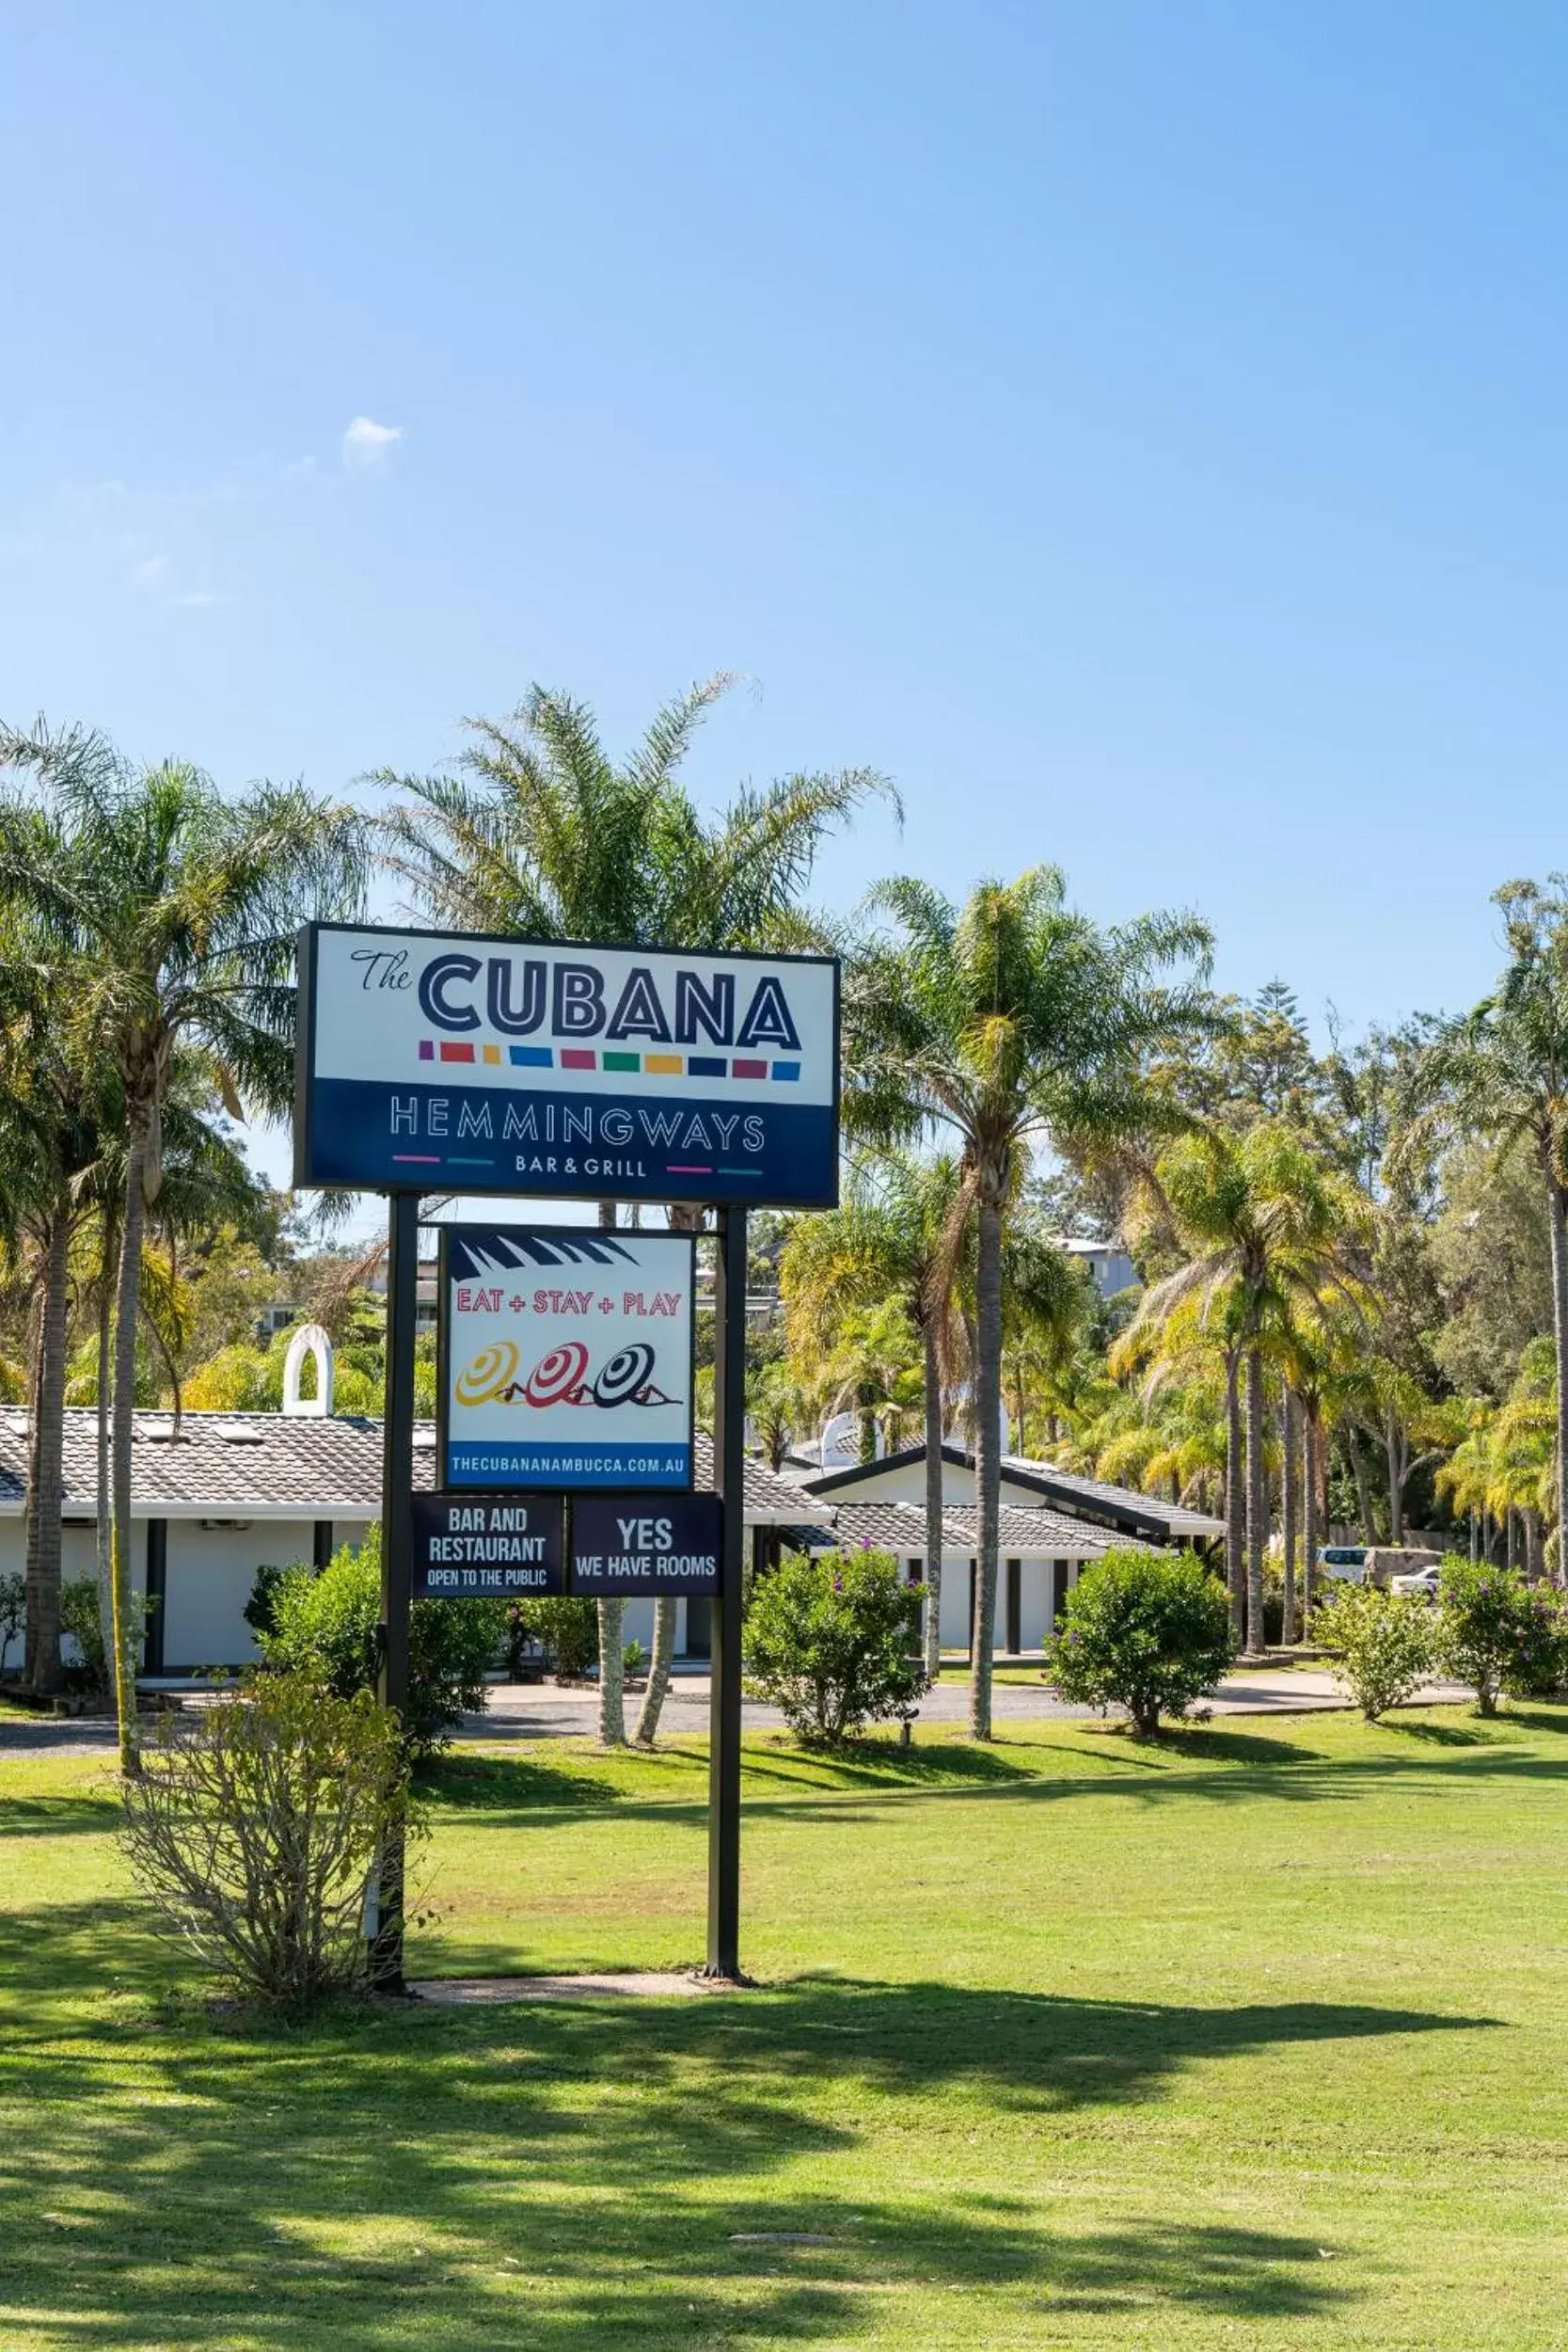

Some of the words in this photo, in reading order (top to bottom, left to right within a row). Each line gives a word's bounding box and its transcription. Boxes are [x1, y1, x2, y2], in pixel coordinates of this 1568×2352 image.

[350, 949, 412, 990] The
[418, 953, 802, 1051] CUBANA
[390, 1095, 766, 1152] HEMMINGWAYS
[457, 1288, 503, 1312] EAT
[532, 1289, 594, 1314] STAY
[623, 1292, 682, 1316] PLAY
[451, 1456, 684, 1472] THECUBANANAMBUCCA.COM.AU
[449, 1508, 487, 1532] BAR
[489, 1508, 527, 1532] AND
[617, 1518, 673, 1550] YES
[429, 1537, 546, 1562] RESTAURANT
[427, 1569, 459, 1585] OPEN
[461, 1569, 477, 1585] TO
[479, 1569, 503, 1585] THE
[505, 1569, 546, 1585] PUBLIC
[576, 1556, 602, 1576] WE
[608, 1556, 651, 1576] HAVE
[656, 1556, 715, 1576] ROOMS
